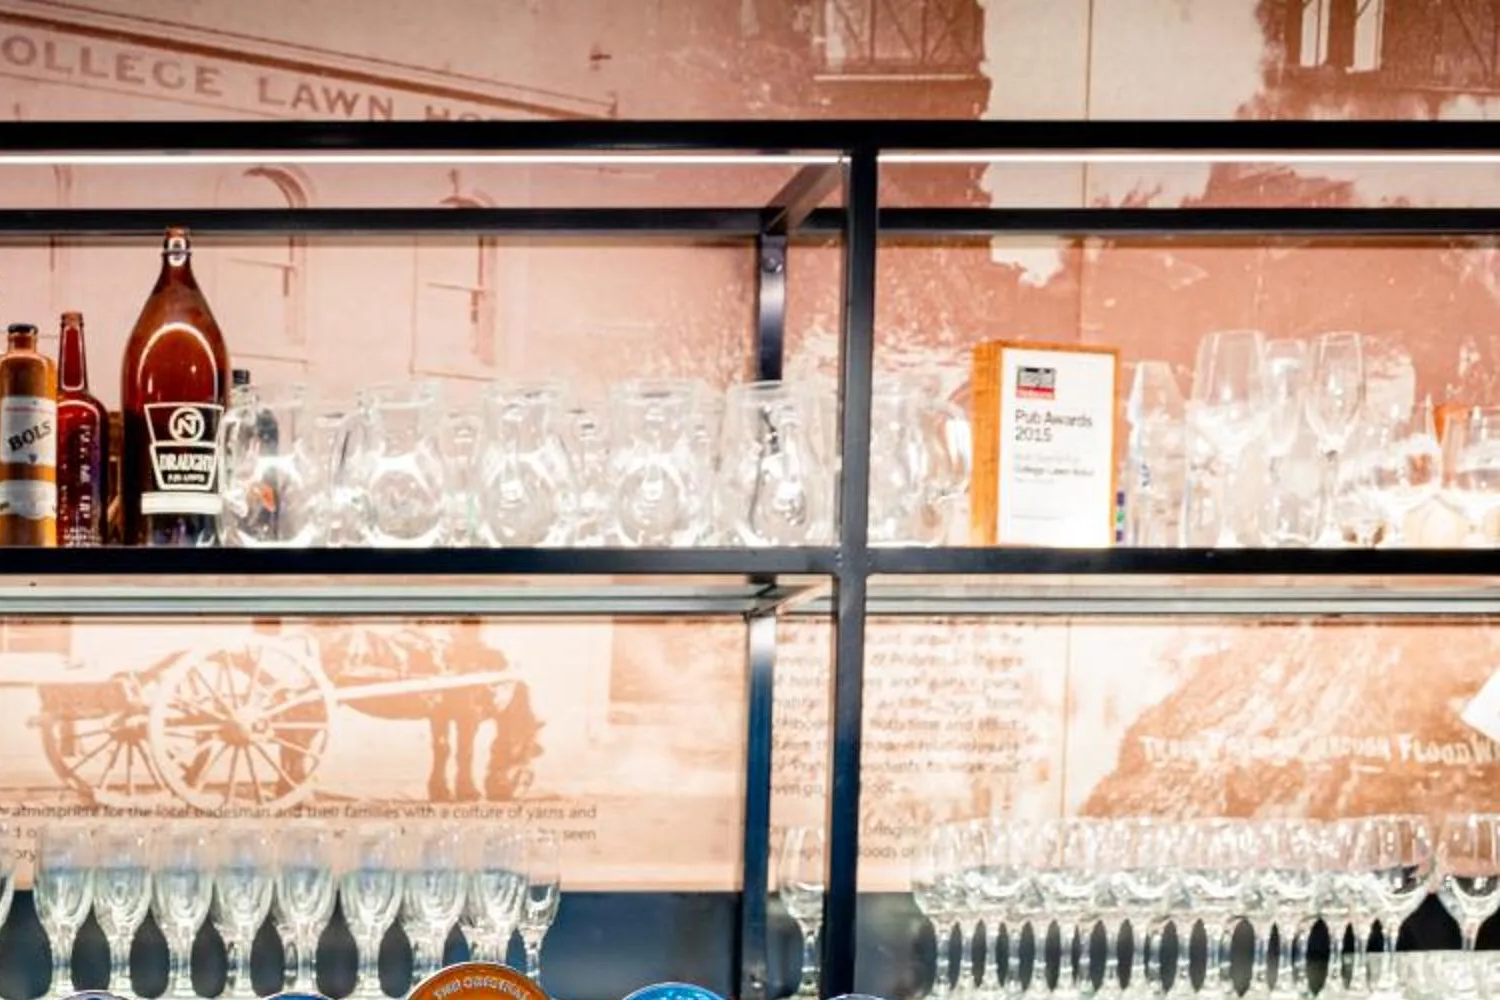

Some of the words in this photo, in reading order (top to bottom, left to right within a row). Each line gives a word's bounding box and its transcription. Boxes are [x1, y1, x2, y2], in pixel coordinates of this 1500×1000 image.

[257, 76, 395, 121] LAWN
[1015, 409, 1040, 425] Pub
[1043, 411, 1093, 429] Awards
[8, 420, 52, 452] BOLS
[1015, 426, 1052, 442] 2015
[344, 804, 400, 819] families
[403, 805, 436, 819] with
[507, 804, 522, 819] of
[526, 807, 564, 822] yarns
[569, 805, 597, 819] and
